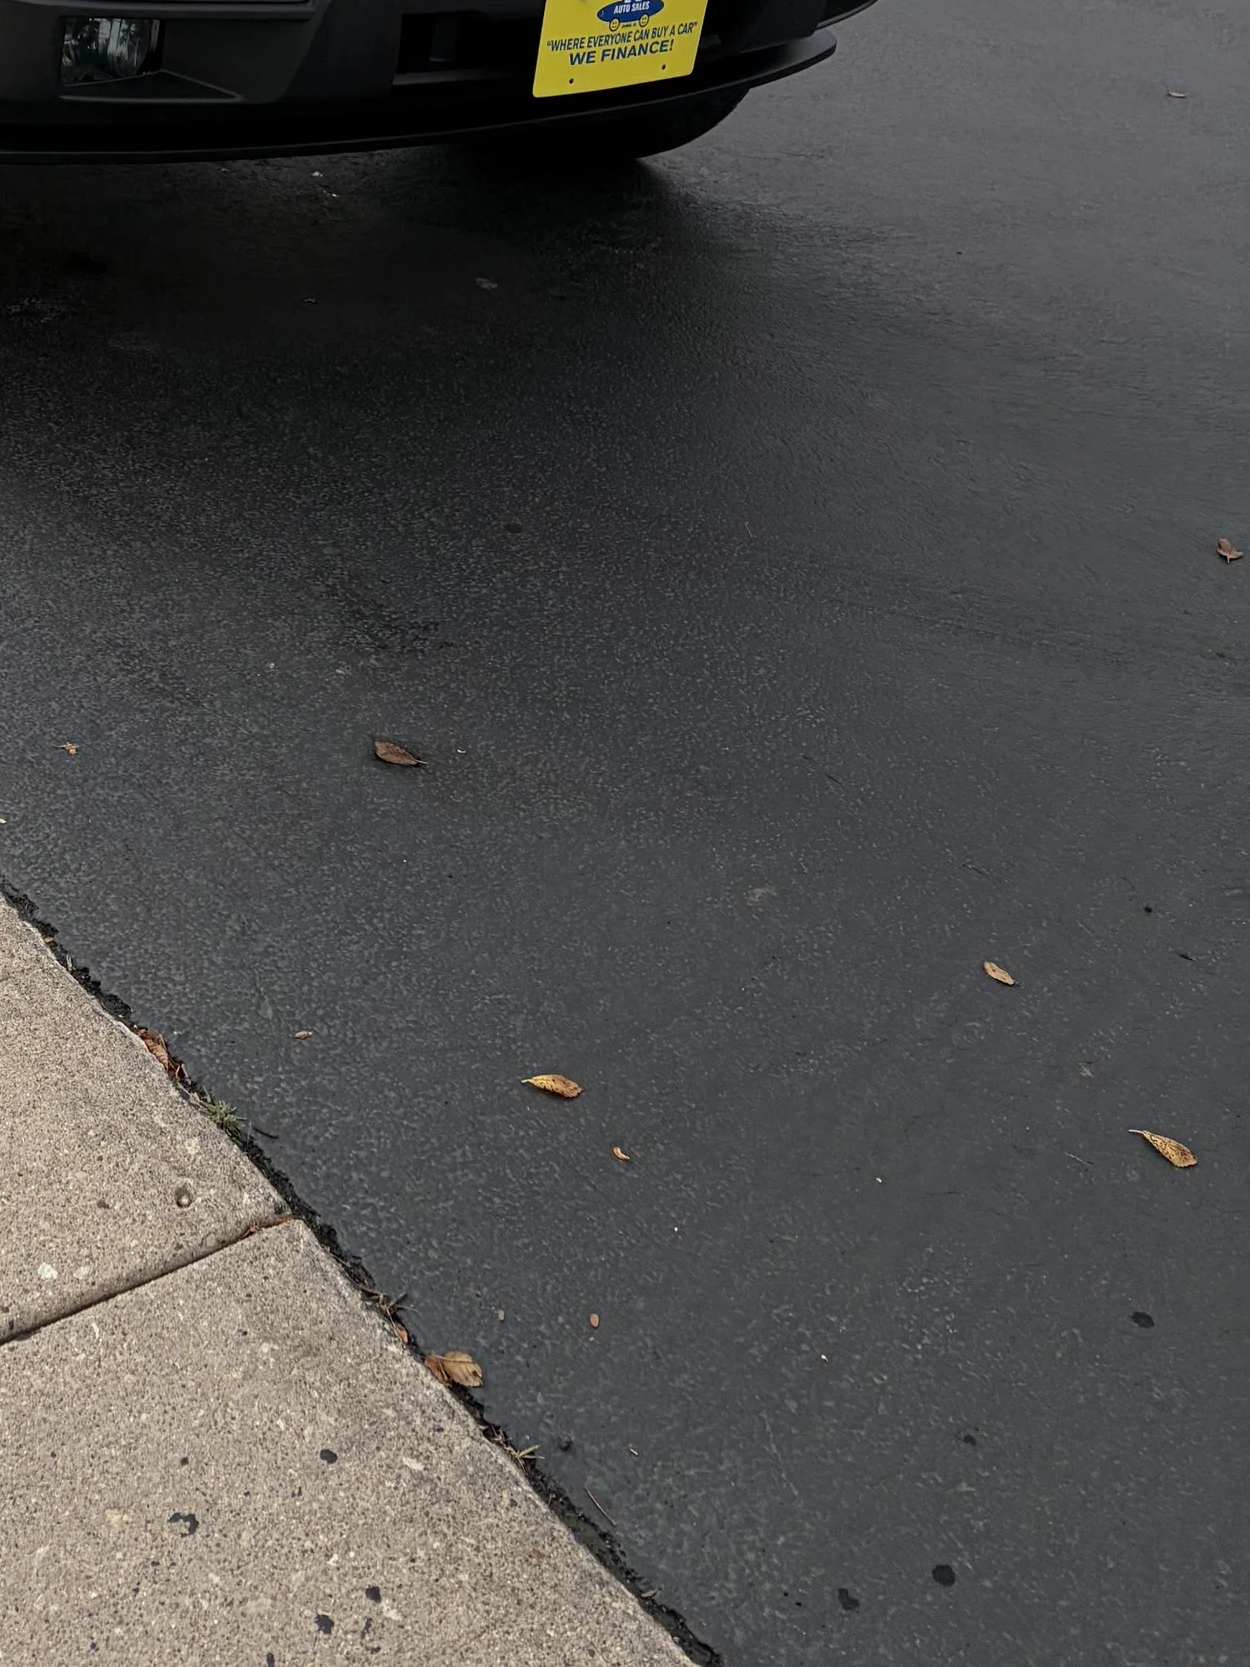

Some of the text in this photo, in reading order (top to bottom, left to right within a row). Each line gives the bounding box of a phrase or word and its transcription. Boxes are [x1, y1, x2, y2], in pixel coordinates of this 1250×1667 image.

[613, 1, 650, 15] AUTO SALES
[587, 32, 633, 48] EVERYONE
[633, 29, 650, 41] CAN
[652, 26, 668, 39] BUY
[569, 39, 675, 66] WE FINANCE!
